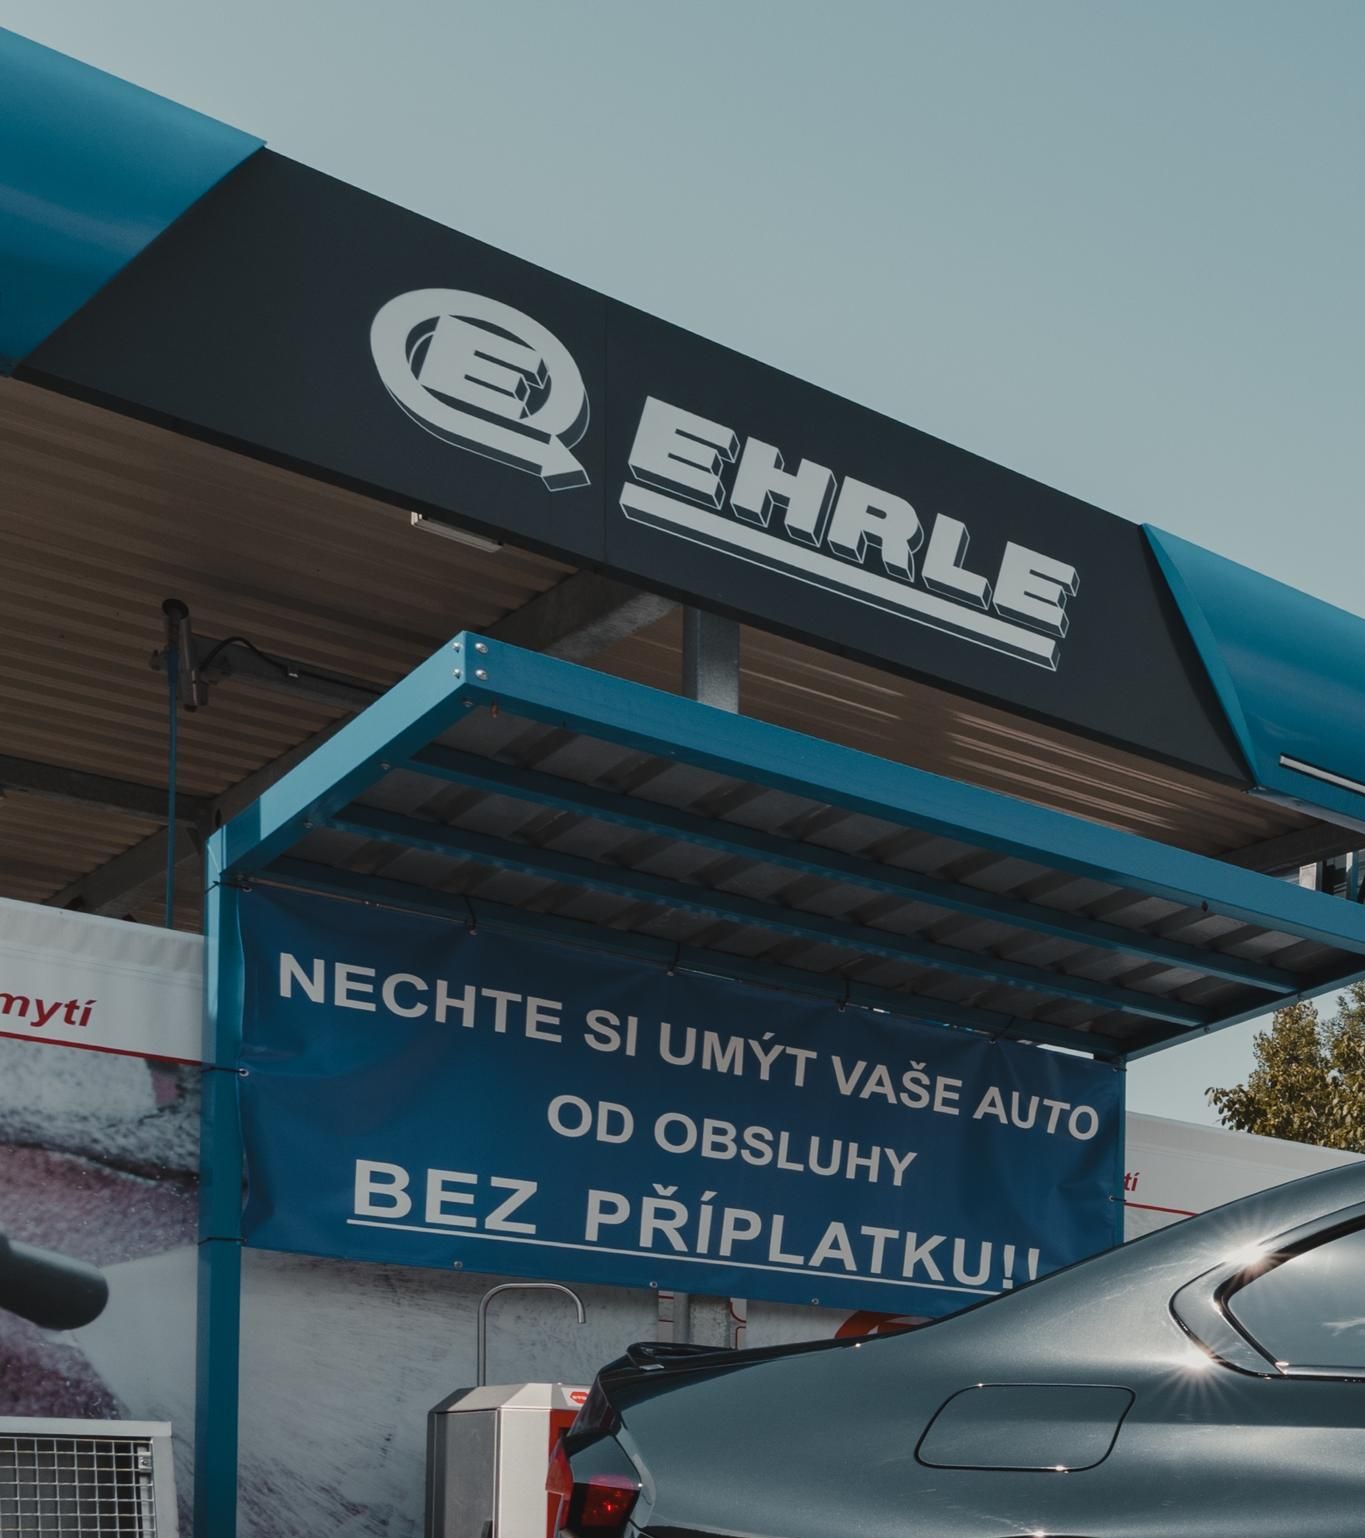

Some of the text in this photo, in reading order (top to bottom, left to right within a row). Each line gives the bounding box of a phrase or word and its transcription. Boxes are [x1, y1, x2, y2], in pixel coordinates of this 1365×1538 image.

[627, 395, 1080, 638] EHRLE
[279, 952, 1100, 1141] NECHTE SI UMÝT VAŠE AUTO
[354, 1159, 538, 1235] BEZ
[547, 1094, 918, 1187] OD OBSLUHY
